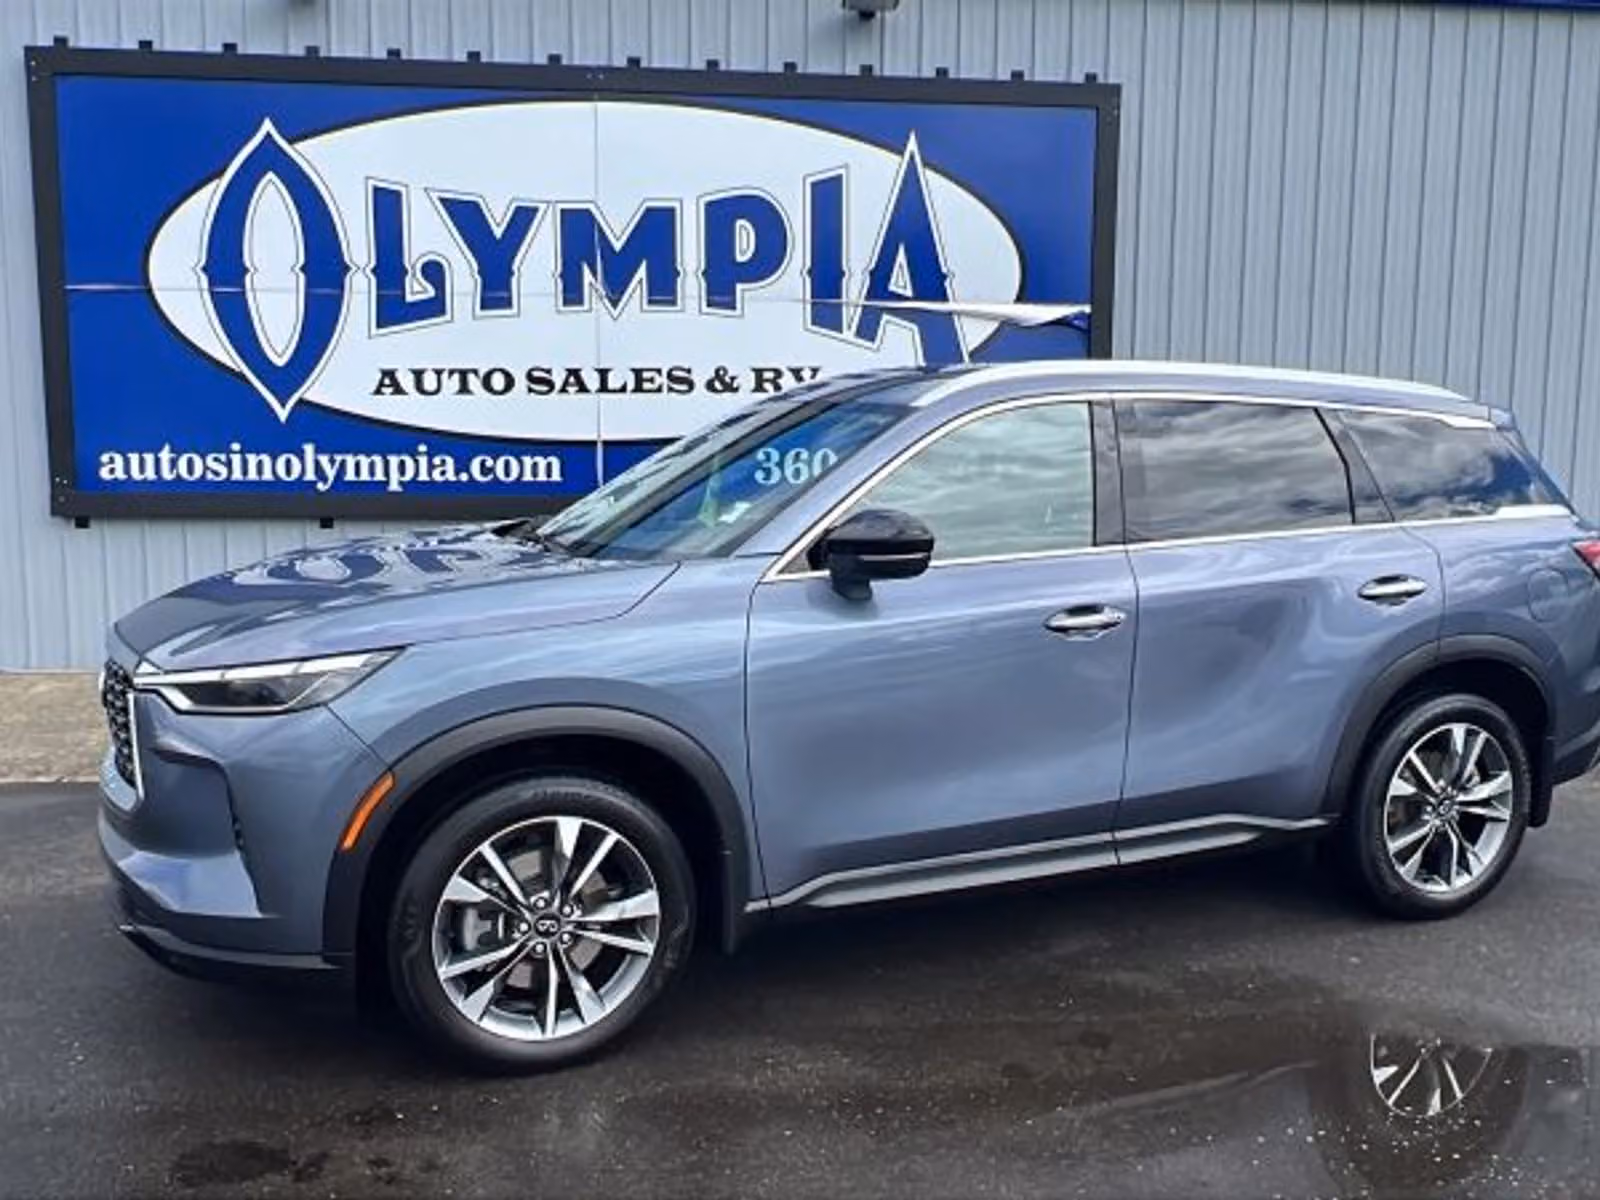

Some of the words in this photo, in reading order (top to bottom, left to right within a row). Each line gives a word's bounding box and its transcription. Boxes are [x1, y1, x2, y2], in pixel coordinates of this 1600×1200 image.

[199, 117, 970, 422] OLYMPIA
[372, 367, 516, 396] AUTO
[525, 366, 695, 395] SALES
[704, 365, 740, 394] &
[99, 443, 562, 491] autosinolympia.com
